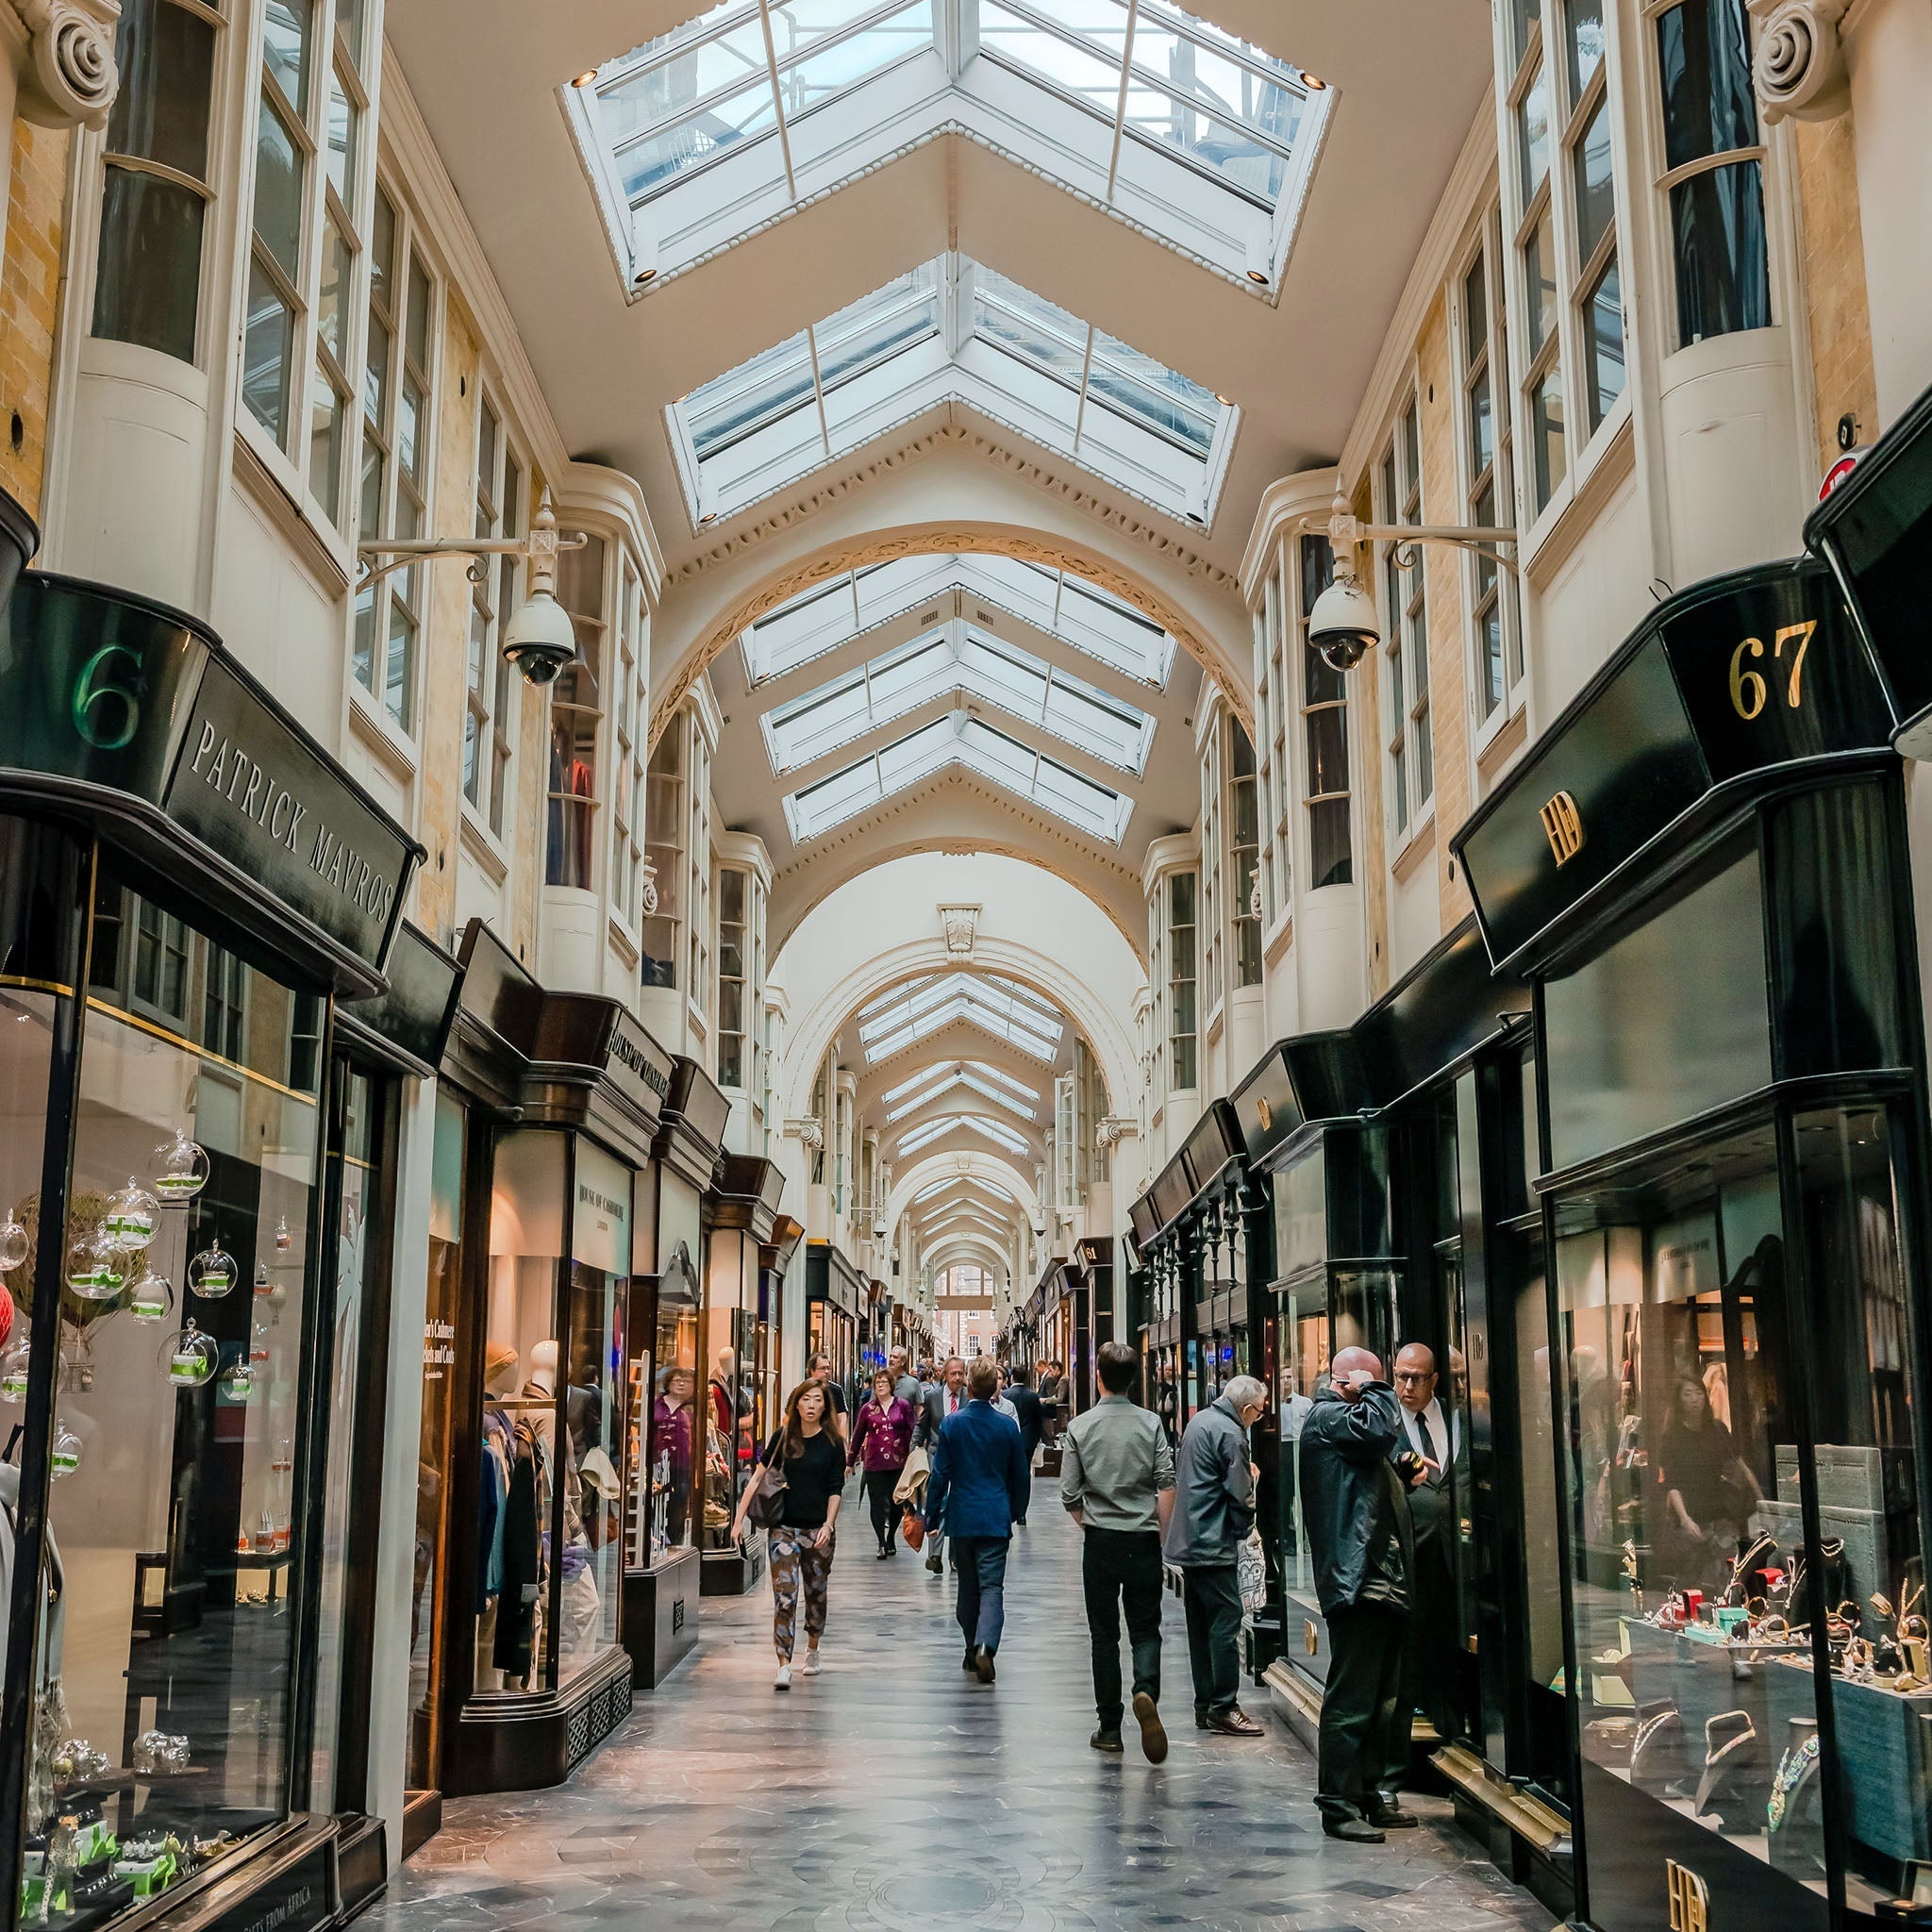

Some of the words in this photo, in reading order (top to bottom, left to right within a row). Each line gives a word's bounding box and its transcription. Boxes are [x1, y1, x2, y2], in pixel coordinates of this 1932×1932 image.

[73, 645, 142, 749] 6
[1729, 620, 1818, 720] 67
[191, 720, 308, 854] PATRICK
[308, 824, 393, 924] MAVROS
[579, 1184, 596, 1207] HOUSE
[1086, 1246, 1097, 1259] 61
[265, 1905, 286, 1932] FROM
[286, 1886, 311, 1918] AFRICA
